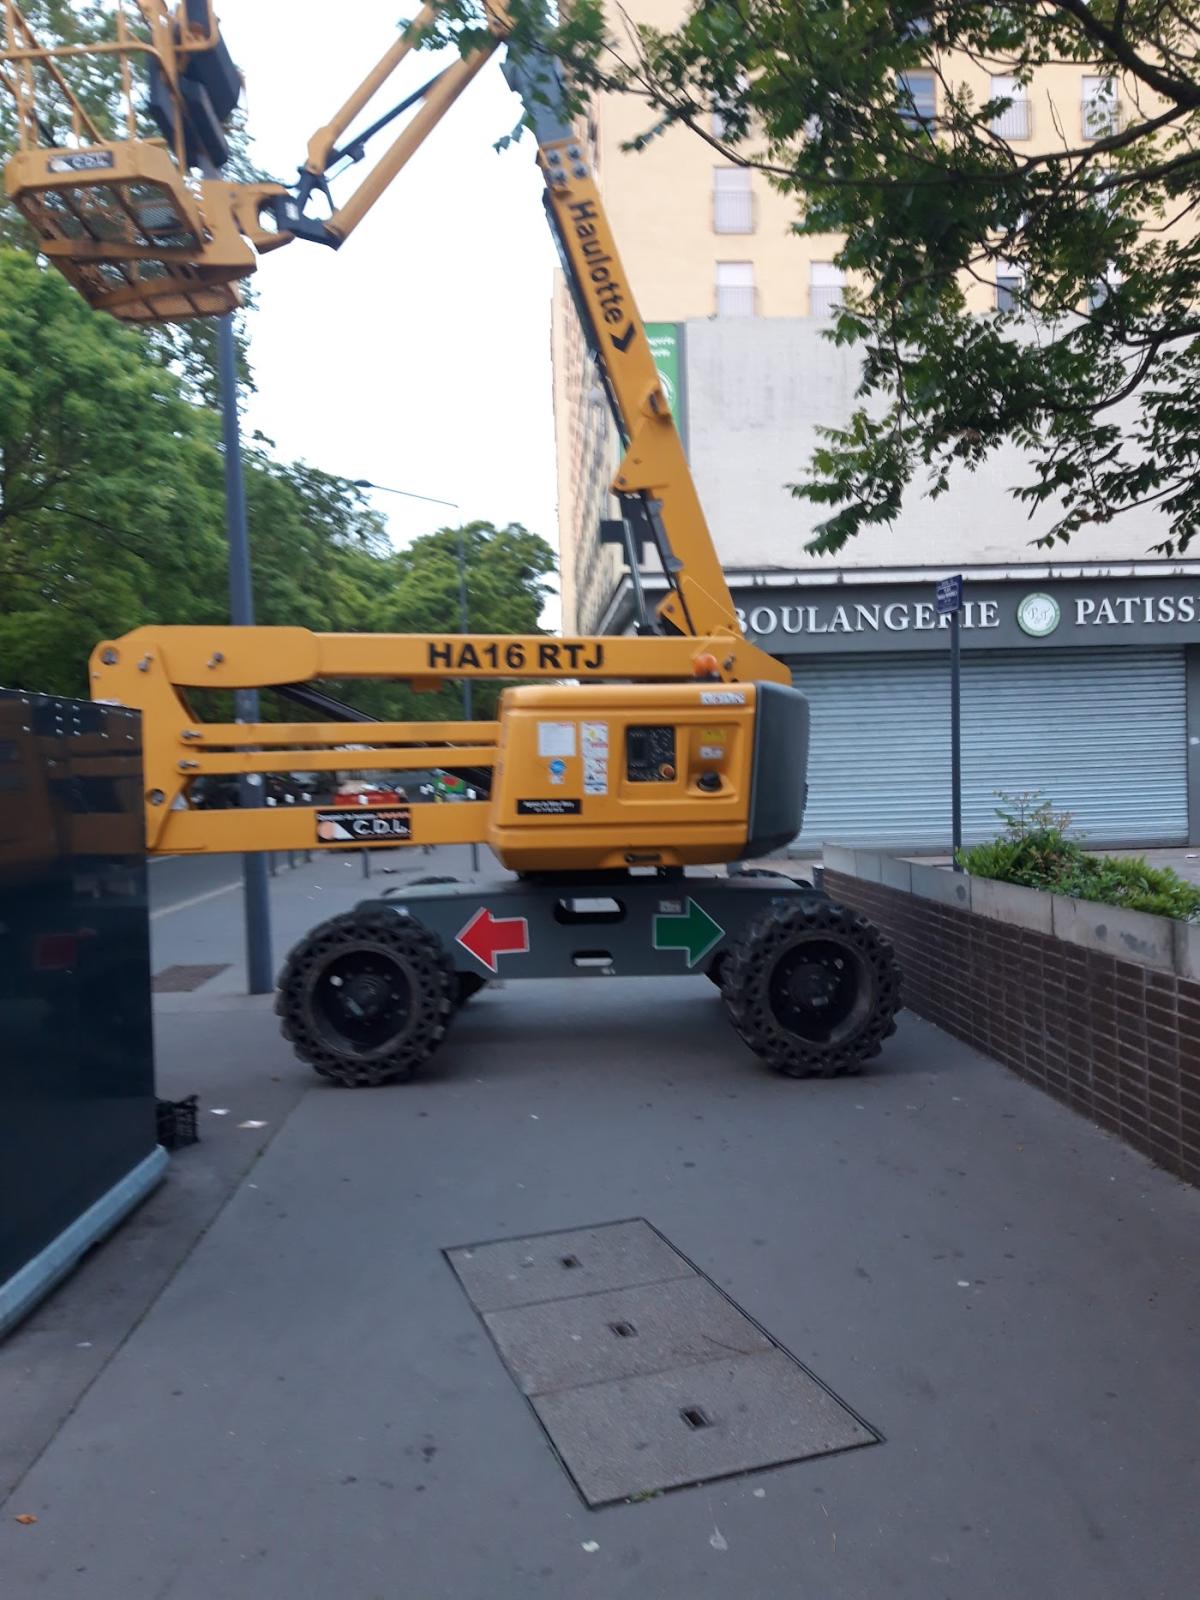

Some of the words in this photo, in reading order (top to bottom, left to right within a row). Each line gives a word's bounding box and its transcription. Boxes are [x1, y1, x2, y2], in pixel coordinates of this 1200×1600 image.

[568, 200, 624, 326] Haulotte
[1074, 596, 1200, 625] PATISS
[428, 642, 526, 669] HA16
[538, 643, 605, 670] RTJ
